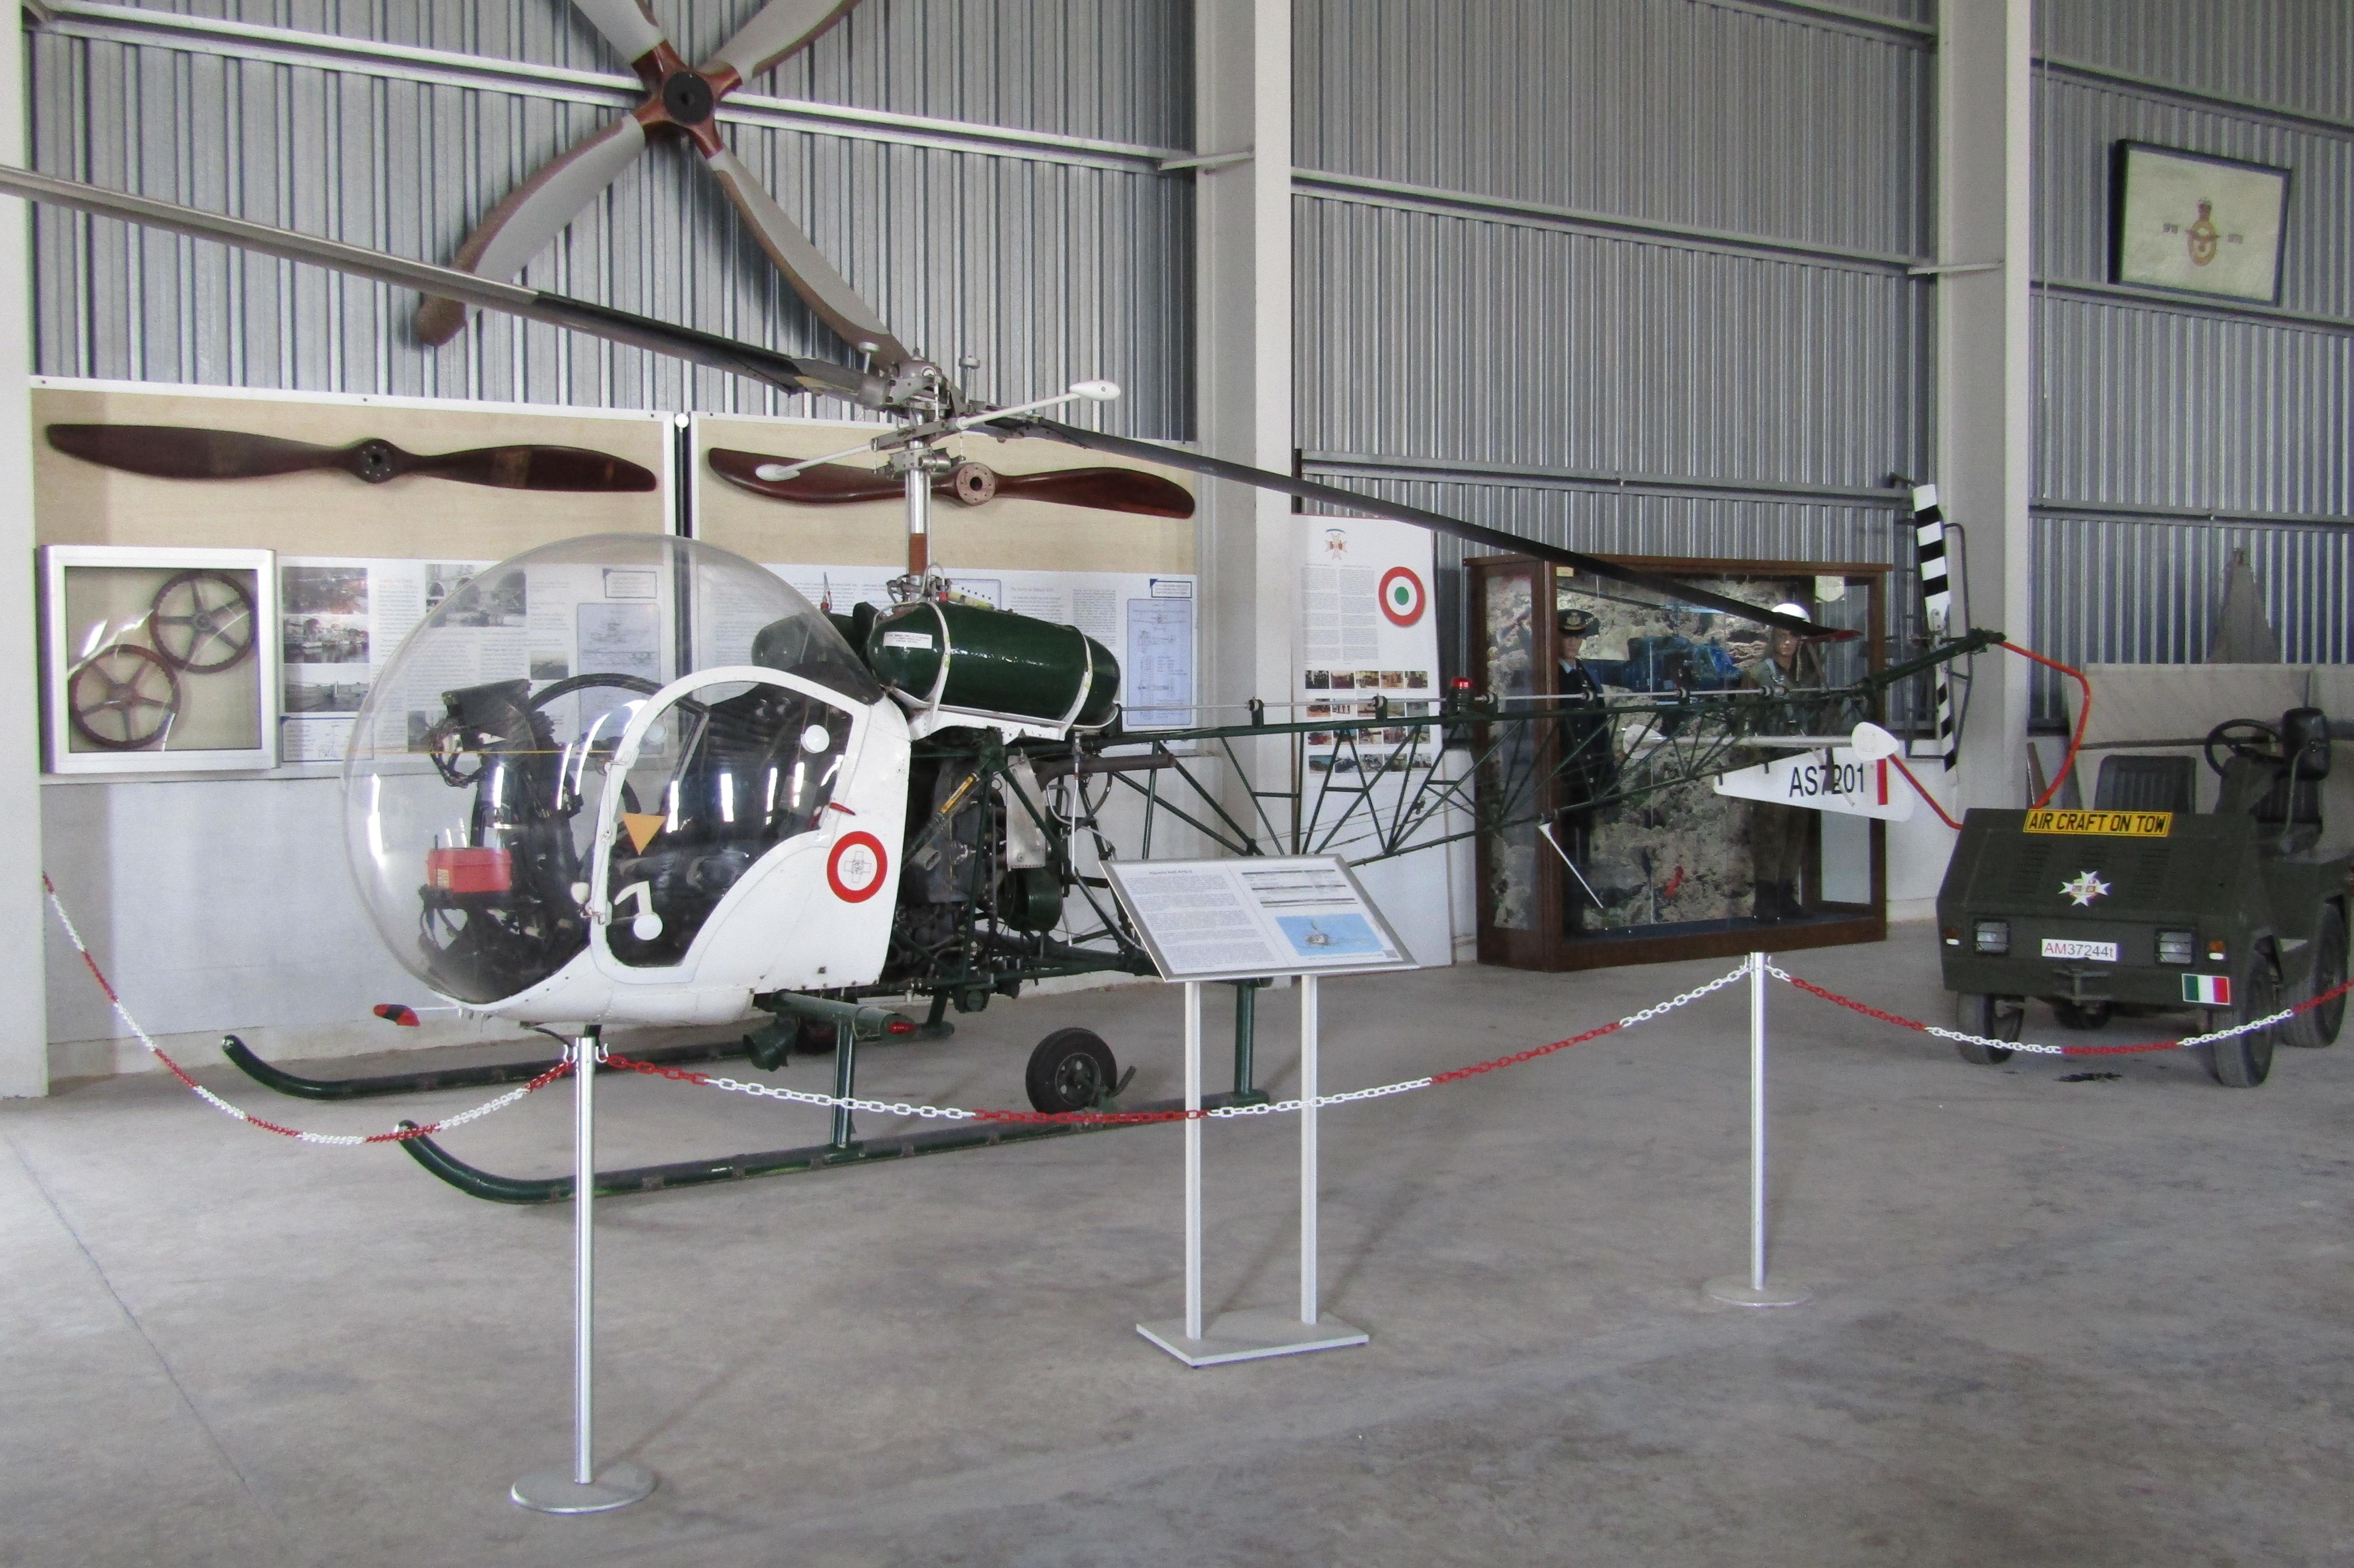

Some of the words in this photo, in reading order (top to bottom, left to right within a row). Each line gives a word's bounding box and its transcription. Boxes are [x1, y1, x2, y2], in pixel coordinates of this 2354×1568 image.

[2029, 812, 2053, 830] AIR
[2056, 813, 2107, 831] CRAFT
[2110, 814, 2132, 832] ON
[2136, 815, 2166, 833] TOW
[2044, 942, 2114, 958] AM37244t
